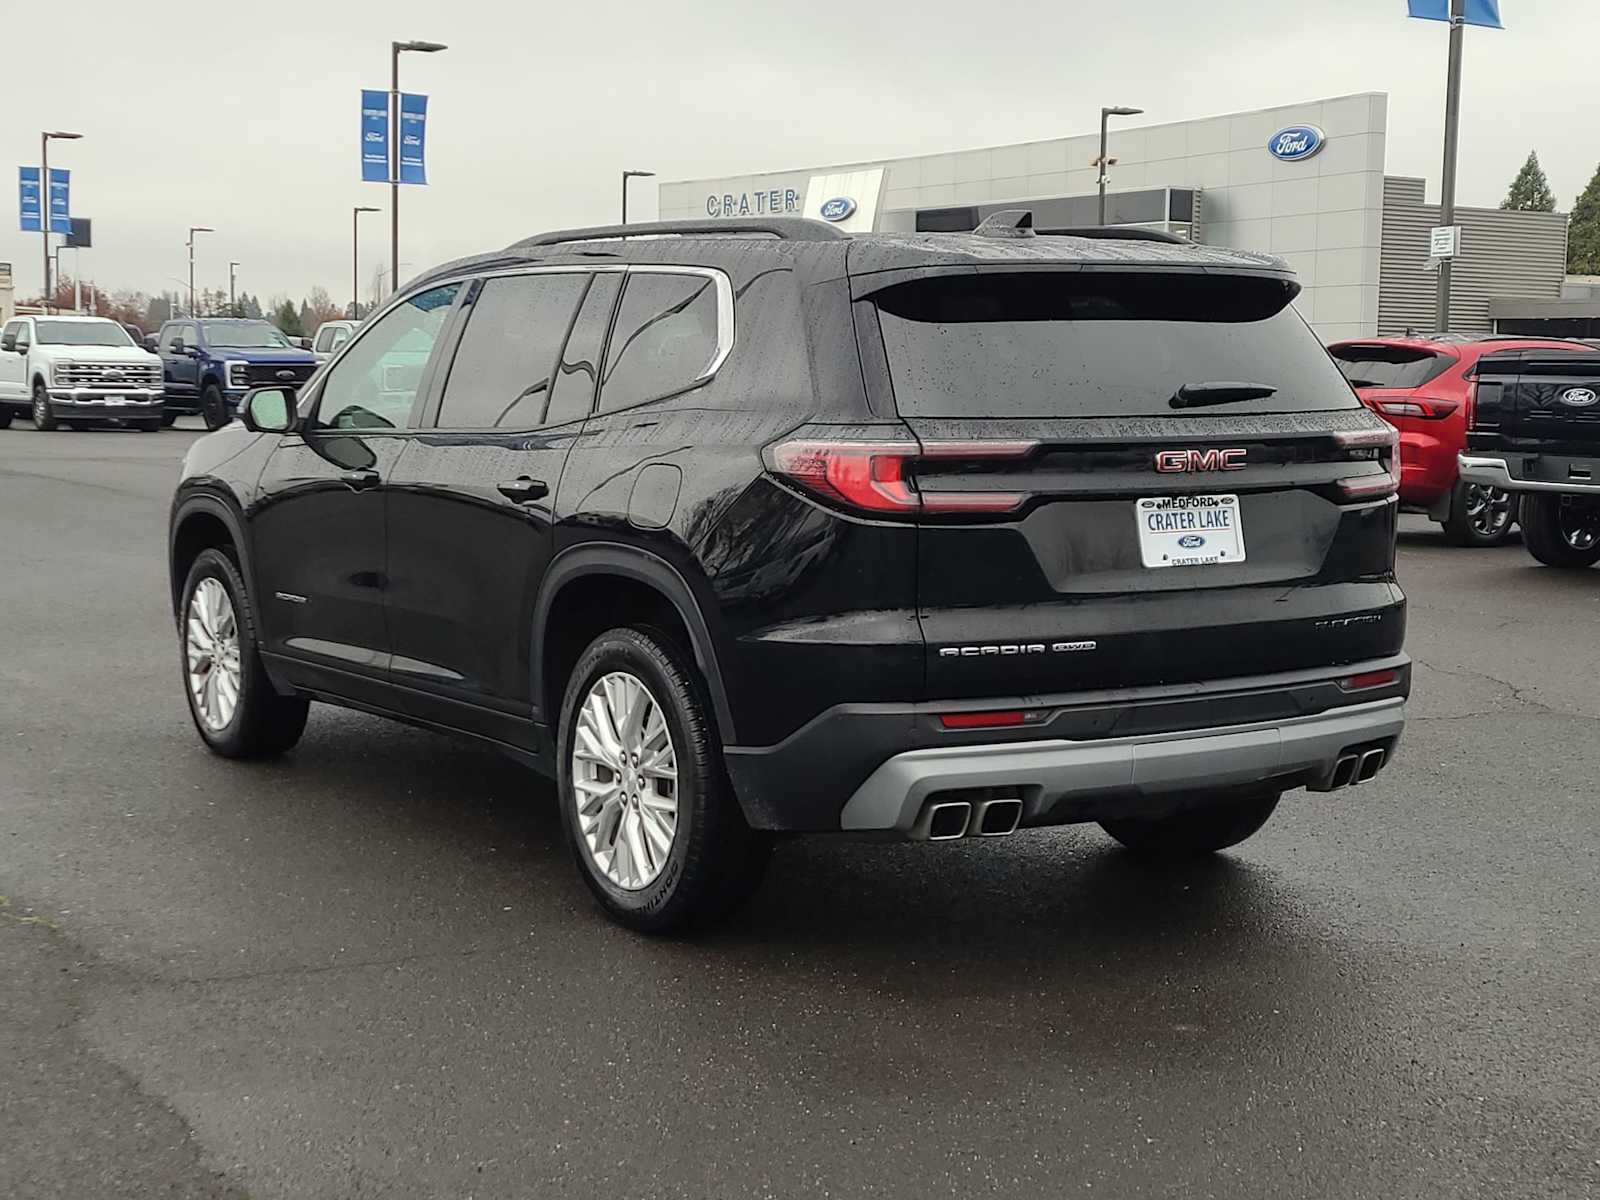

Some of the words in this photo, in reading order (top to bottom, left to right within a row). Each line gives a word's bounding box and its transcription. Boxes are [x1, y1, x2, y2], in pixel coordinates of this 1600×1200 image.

[1276, 132, 1308, 154] Ford
[706, 189, 797, 217] CRATER
[824, 201, 846, 216] Ford
[1568, 390, 1591, 401] Ford
[1155, 448, 1247, 472] GMC
[1162, 497, 1215, 510] MEDFORD
[1147, 511, 1196, 532] CRATER
[1198, 510, 1230, 529] LAKE
[939, 644, 1046, 657] ACADIA
